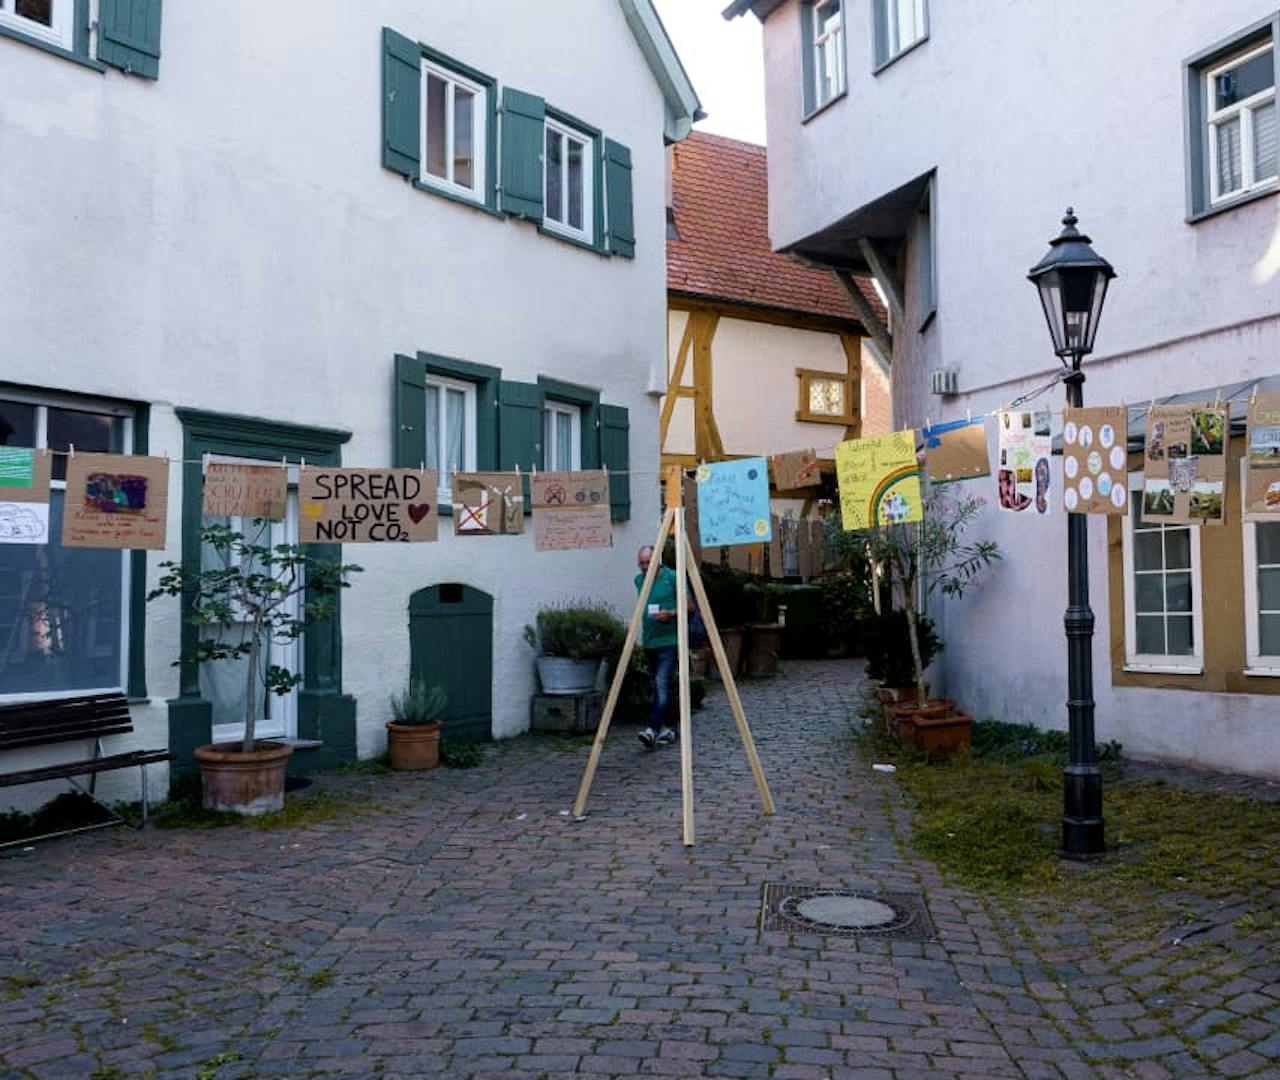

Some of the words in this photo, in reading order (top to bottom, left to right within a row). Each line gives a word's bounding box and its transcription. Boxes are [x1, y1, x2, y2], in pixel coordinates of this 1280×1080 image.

[312, 474, 420, 500] SPREAD
[342, 504, 400, 521] LOVE
[316, 520, 361, 540] NOT
